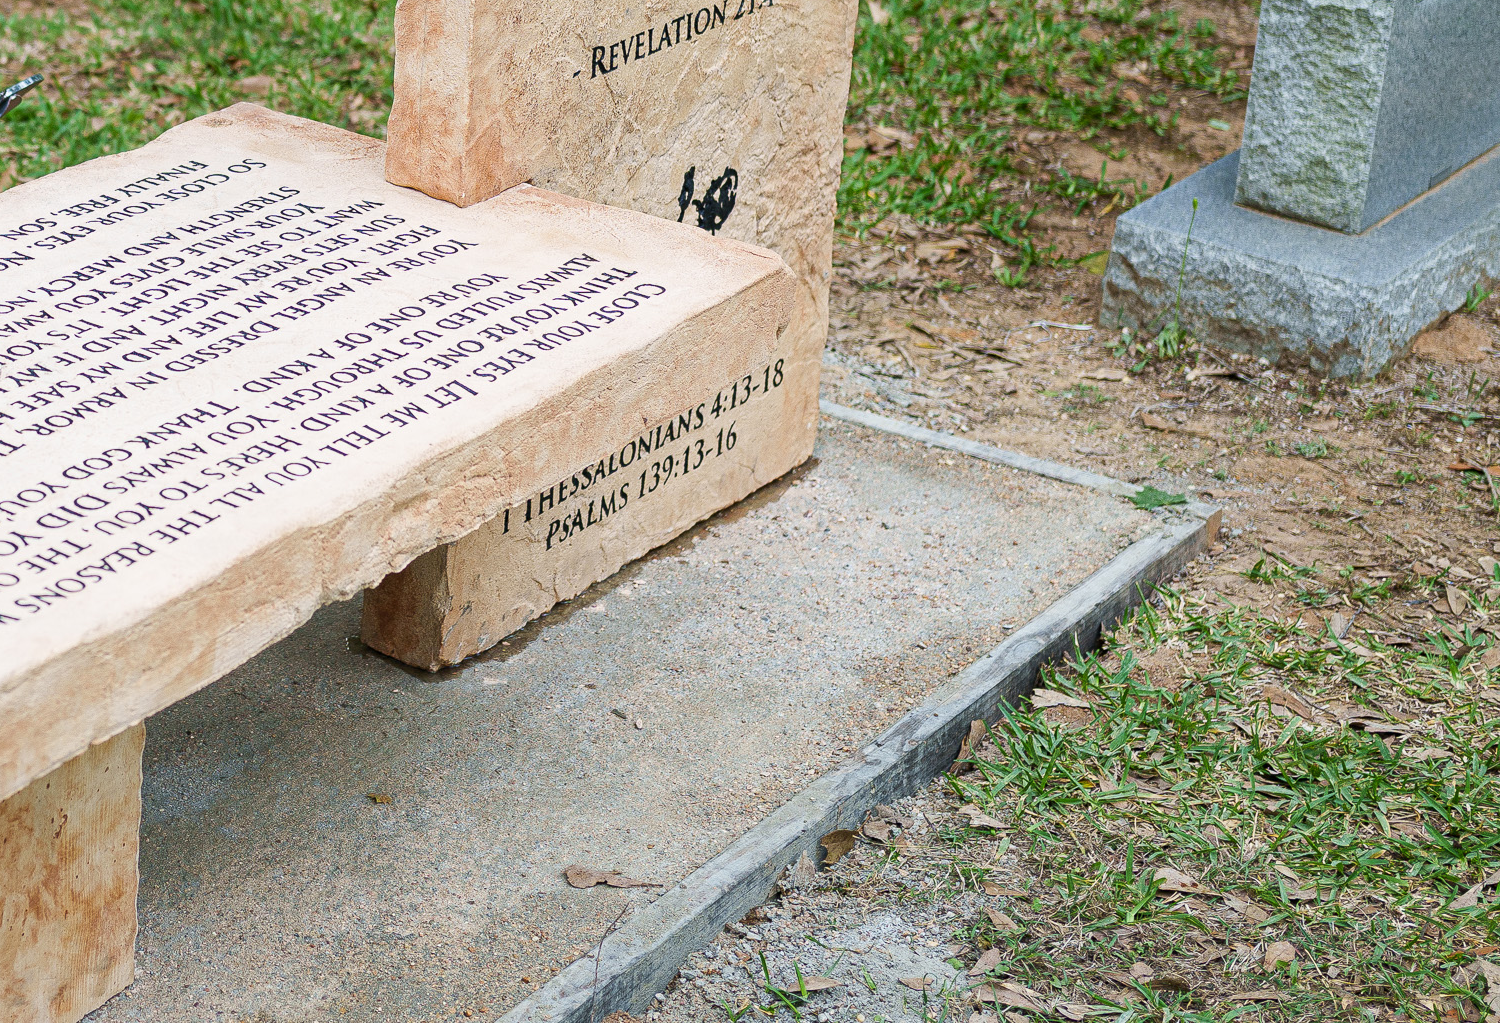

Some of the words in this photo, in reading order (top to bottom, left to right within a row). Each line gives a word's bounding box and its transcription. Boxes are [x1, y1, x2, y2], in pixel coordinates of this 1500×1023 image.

[591, 0, 728, 79] REVELATION
[114, 159, 210, 199] FINALLY
[226, 157, 268, 175] SO
[154, 172, 231, 203] CLOSE
[49, 193, 122, 219] FREE,
[85, 200, 166, 227] YOUR
[175, 185, 301, 236] STRENGTH
[244, 202, 326, 230] YOUR
[312, 199, 386, 230] WANT
[25, 224, 97, 251] EYES.
[122, 230, 182, 257] AND
[179, 227, 257, 258] SMILE
[234, 239, 284, 259] SEE
[278, 225, 322, 243] TO
[359, 224, 442, 257] FIGHT.
[183, 255, 246, 281] THE
[385, 238, 480, 272] YOU'RE
[26, 254, 127, 298] MERCY,
[108, 255, 186, 290] GIVES
[270, 256, 370, 294] YOU'RE
[350, 266, 393, 287] AN
[516, 252, 601, 295] ALWAYS
[551, 266, 639, 308] THINK
[53, 287, 118, 314] YOU
[100, 277, 193, 318] LIGHT.
[233, 289, 280, 314] MY
[269, 281, 357, 322] ANGEL
[417, 272, 510, 309] YOU'RE
[587, 282, 667, 325] CLOSE
[178, 309, 241, 340] LIFE
[363, 305, 427, 335] ONE
[434, 289, 527, 331] PULLED
[476, 302, 569, 344] YOU'RE
[45, 318, 105, 342] IT'S
[164, 319, 281, 373] DRESSED
[332, 331, 374, 353] OF
[398, 329, 444, 350] US
[522, 319, 602, 352] YOUR
[121, 333, 184, 364] AND
[306, 347, 336, 360] A
[422, 339, 486, 371] ONE
[465, 347, 537, 383] EYES.
[76, 361, 125, 385] MY
[125, 370, 170, 392] IN
[232, 358, 318, 394] KIND.
[264, 347, 411, 412] THROUGH.
[364, 382, 395, 397] A
[391, 366, 433, 389] OF
[710, 358, 785, 419] 4:13-18
[9, 379, 82, 413] SAFE
[14, 385, 129, 437] ARMOR,
[423, 378, 480, 410] LET
[124, 400, 241, 450] THANK
[206, 413, 280, 447] YOU
[290, 394, 377, 433] KIND.
[379, 401, 430, 429] ME
[199, 434, 304, 481] HERE'S
[318, 423, 392, 458] TELL
[61, 447, 134, 481] GOD
[102, 441, 209, 495] ALWAYS
[263, 455, 332, 487] YOU
[158, 479, 210, 502] TO
[207, 481, 266, 509] ALL
[545, 482, 630, 551] PSALMS
[638, 422, 737, 499] 139:13-16
[35, 492, 112, 530] DID
[81, 501, 166, 536] YOU,
[148, 509, 222, 545] THE
[16, 538, 93, 574] THE
[13, 540, 157, 614] REASONS
